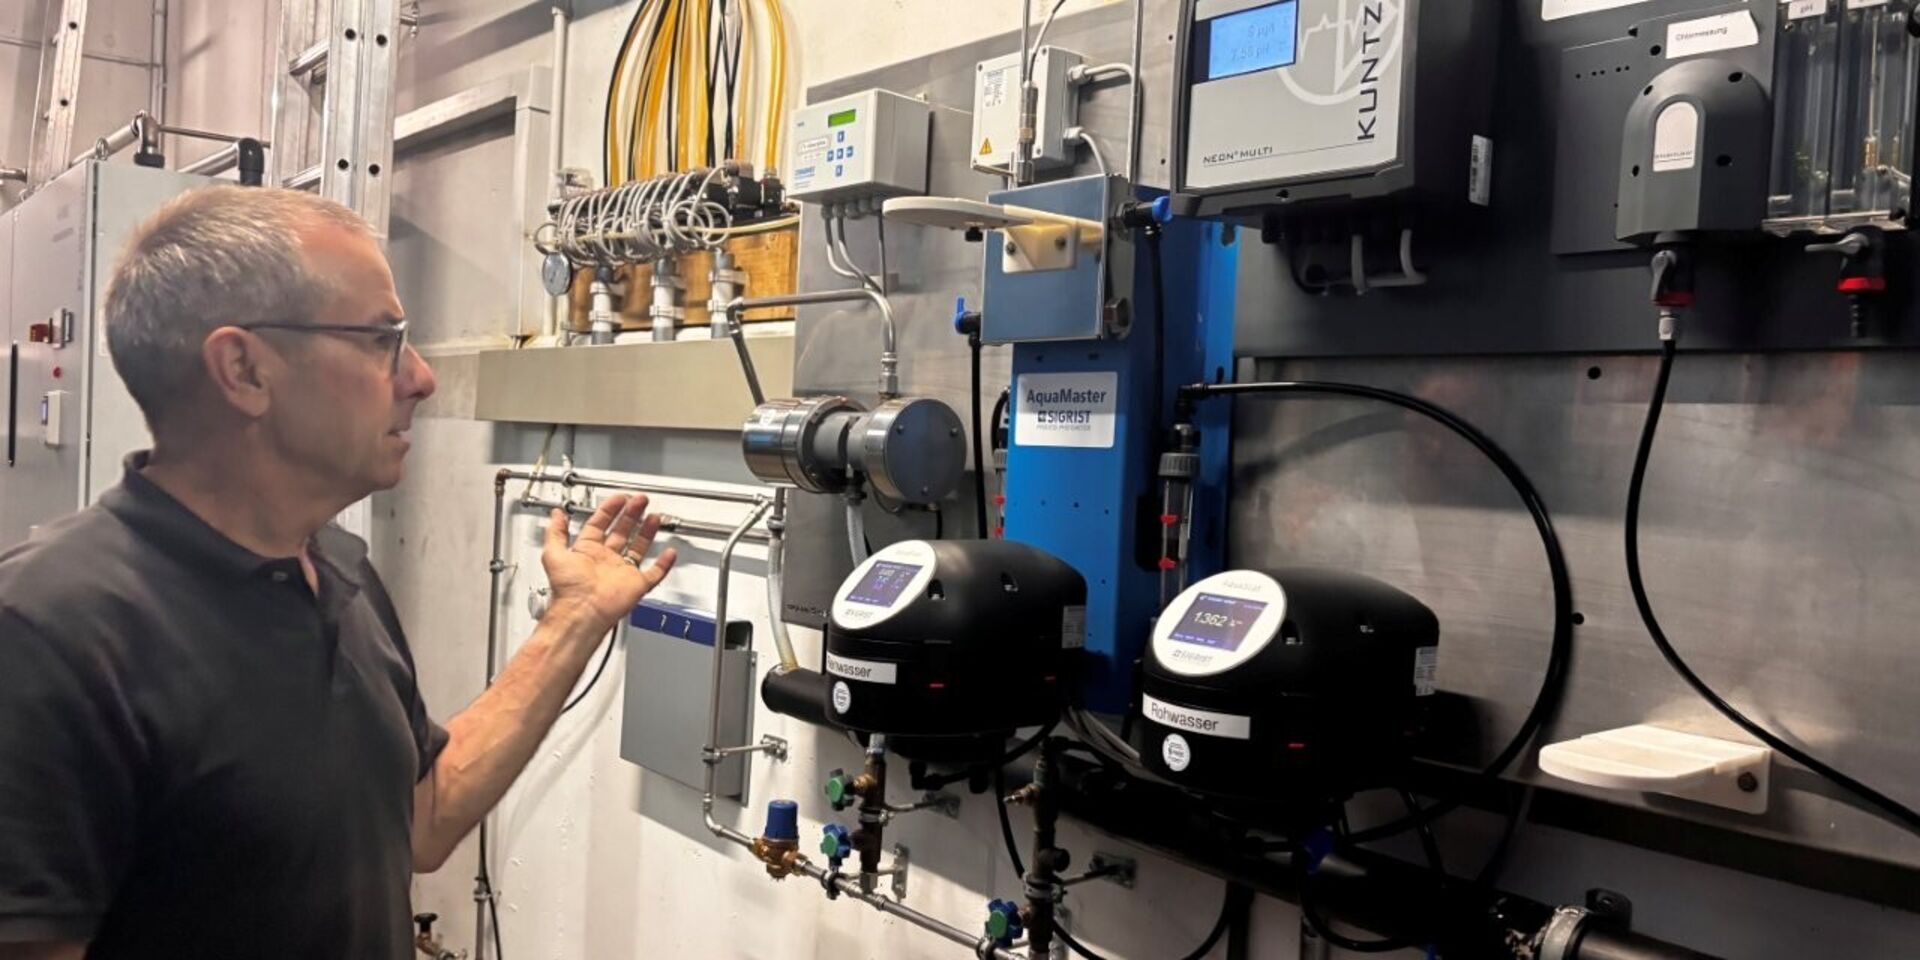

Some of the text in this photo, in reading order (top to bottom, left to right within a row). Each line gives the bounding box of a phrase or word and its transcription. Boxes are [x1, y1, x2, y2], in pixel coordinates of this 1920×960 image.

[1026, 388, 1107, 407] AquaMaster
[1048, 410, 1091, 424] SIGRIST
[1151, 702, 1219, 731] Rohwasser
